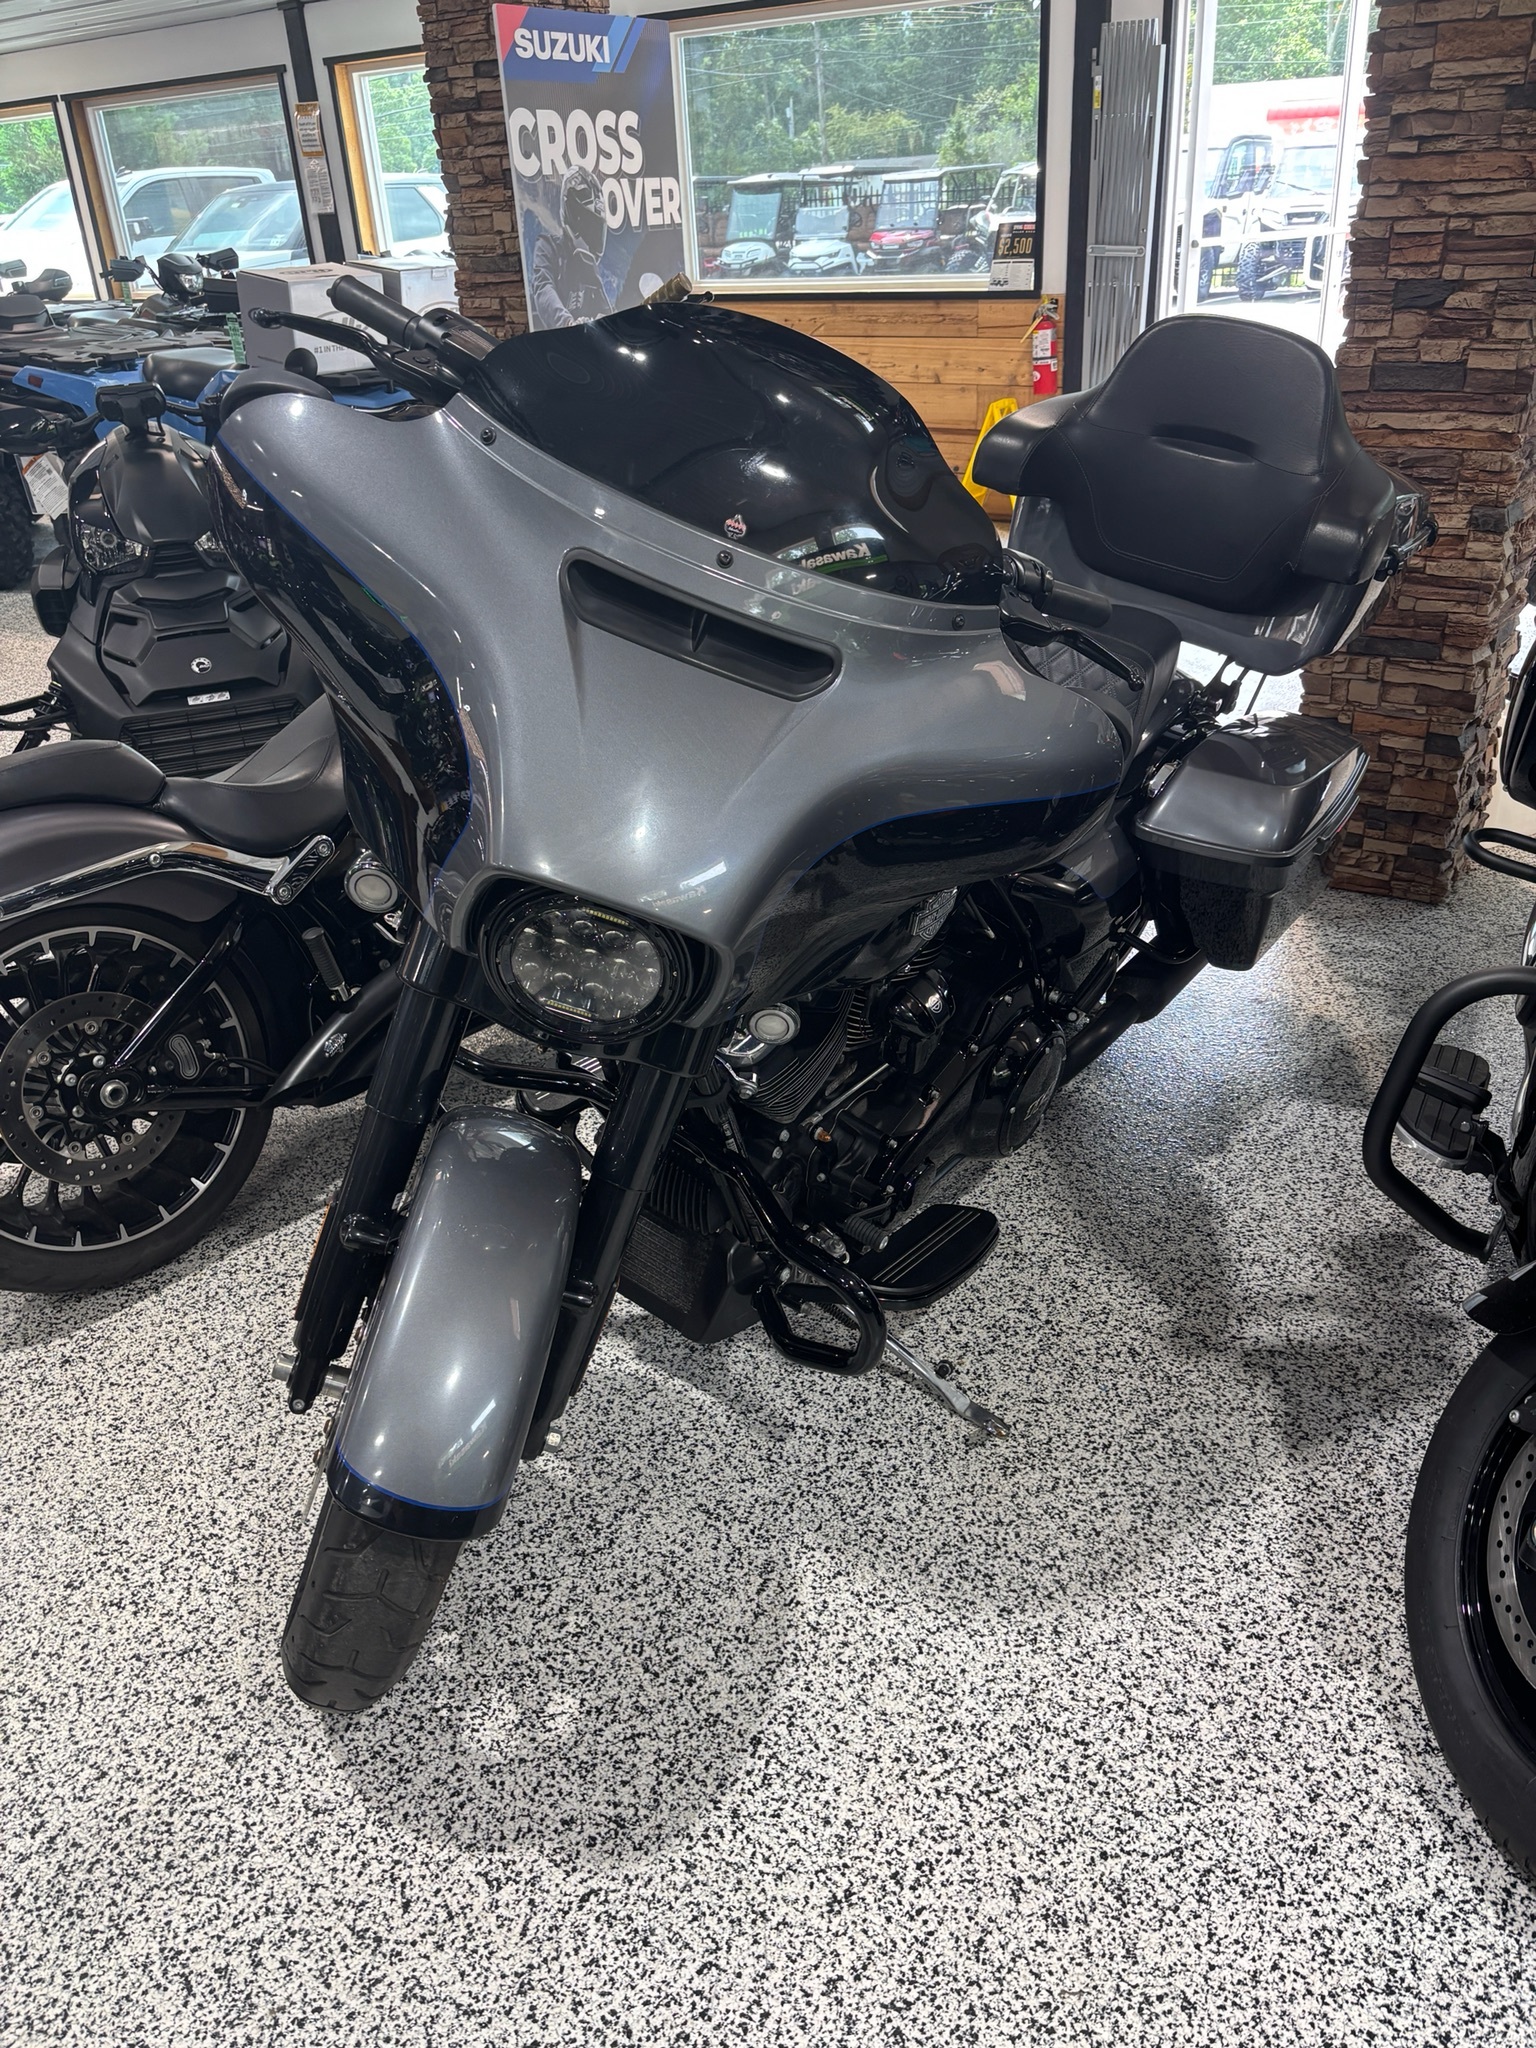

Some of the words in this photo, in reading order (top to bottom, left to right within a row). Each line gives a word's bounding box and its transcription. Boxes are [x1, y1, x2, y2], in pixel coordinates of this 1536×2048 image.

[513, 28, 611, 64] SUZUKI
[509, 107, 643, 178] CROSS
[604, 177, 682, 230] OVER
[997, 237, 1033, 256] $2,500
[324, 345, 331, 353] IN
